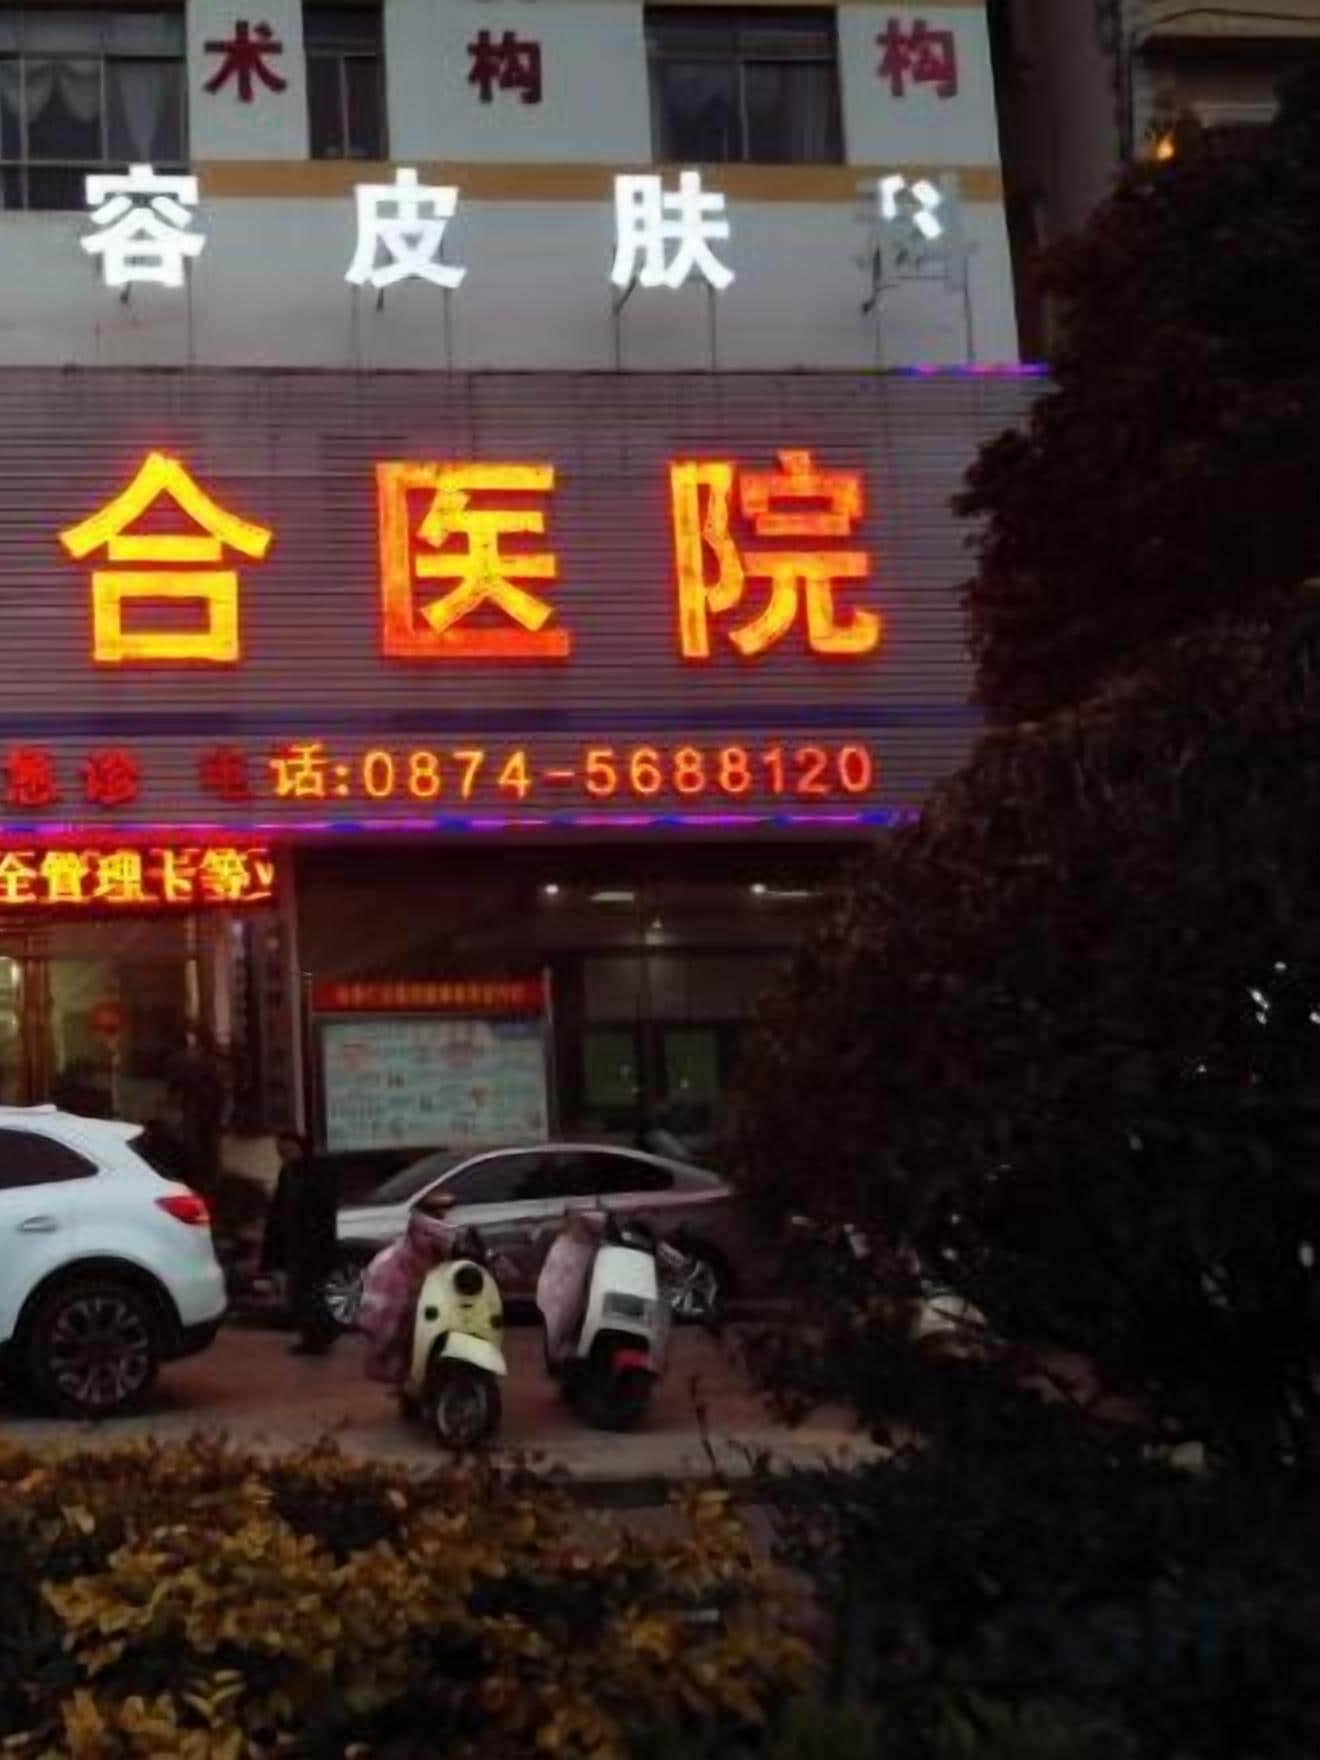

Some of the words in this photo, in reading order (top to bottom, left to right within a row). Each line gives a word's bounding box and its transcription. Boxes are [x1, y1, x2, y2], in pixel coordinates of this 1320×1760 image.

[204, 21, 286, 101] 术
[467, 29, 543, 105] 构
[876, 18, 958, 99] 构
